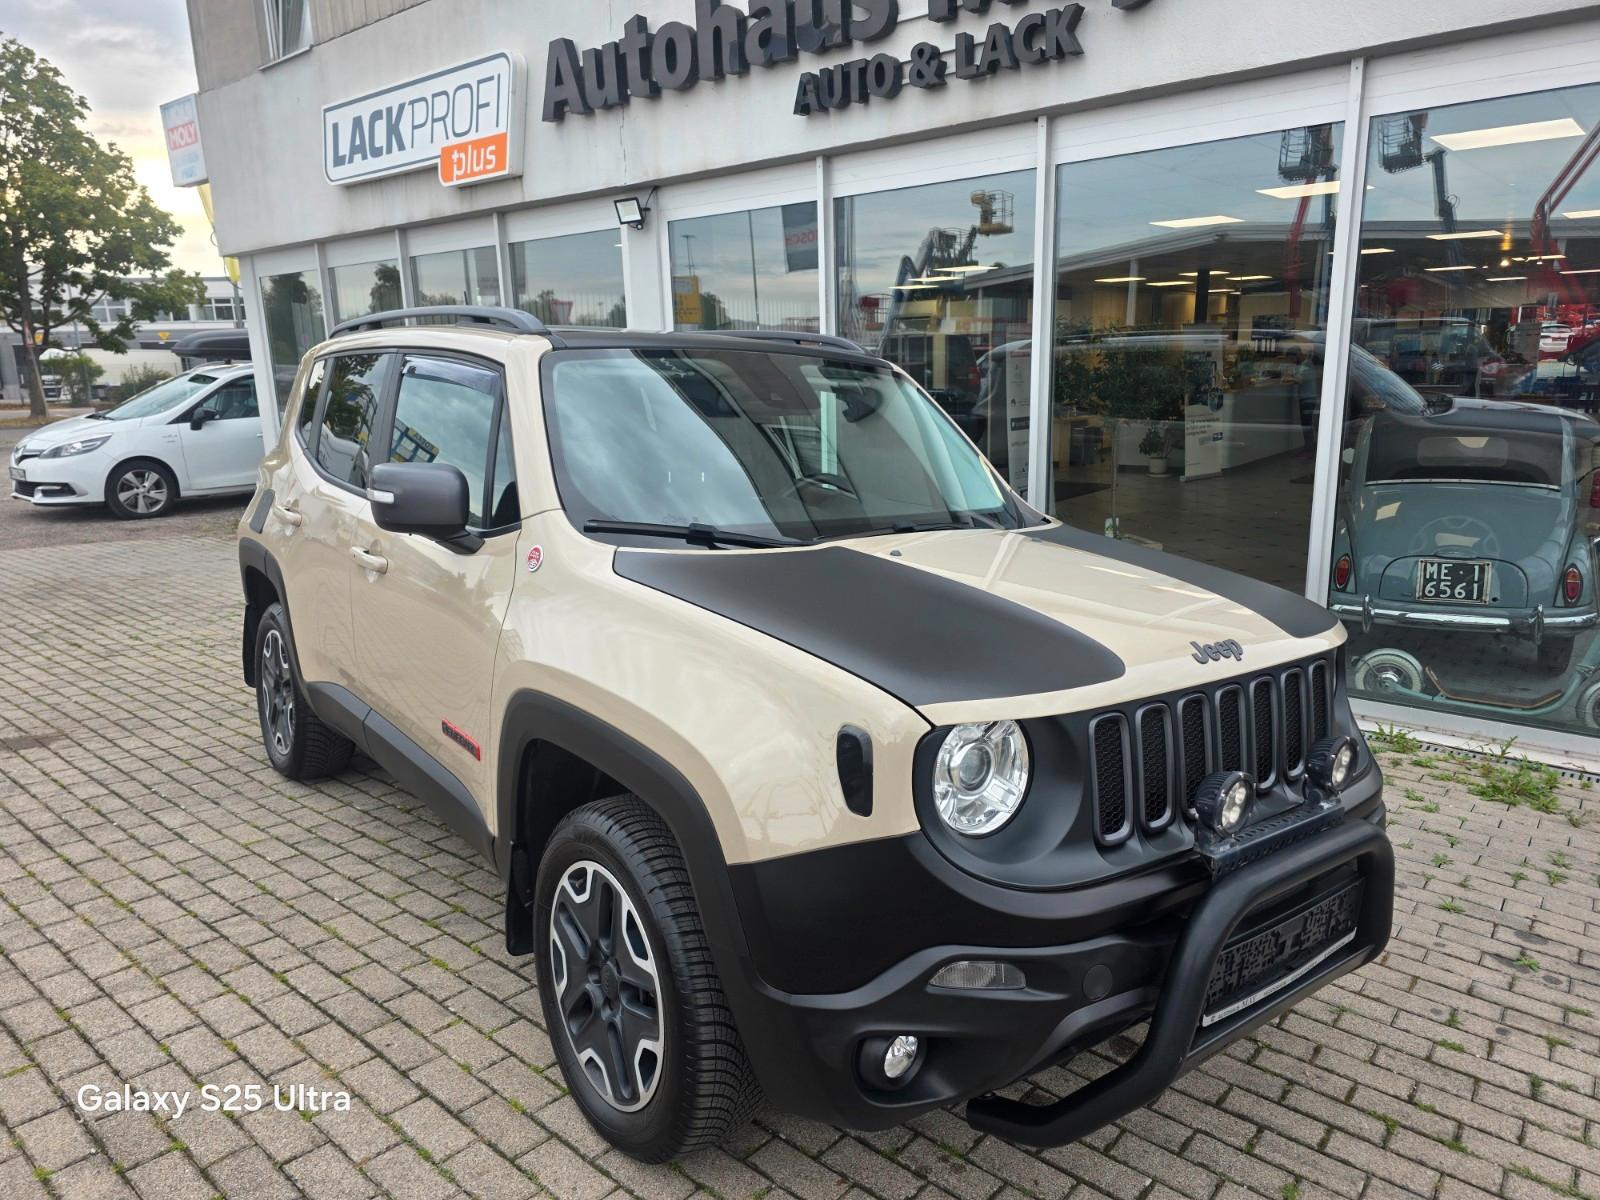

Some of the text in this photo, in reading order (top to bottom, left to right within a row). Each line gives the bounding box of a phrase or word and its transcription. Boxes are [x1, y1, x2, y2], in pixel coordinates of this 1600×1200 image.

[541, 0, 899, 122] Autohaus
[793, 3, 1085, 116] AUTO & LACK
[168, 121, 199, 150] MOLY
[332, 73, 502, 168] LACKPROFI
[451, 144, 497, 182] plus
[1426, 562, 1453, 580] ME
[1424, 581, 1479, 600] 6561
[1189, 638, 1243, 665] Jeep
